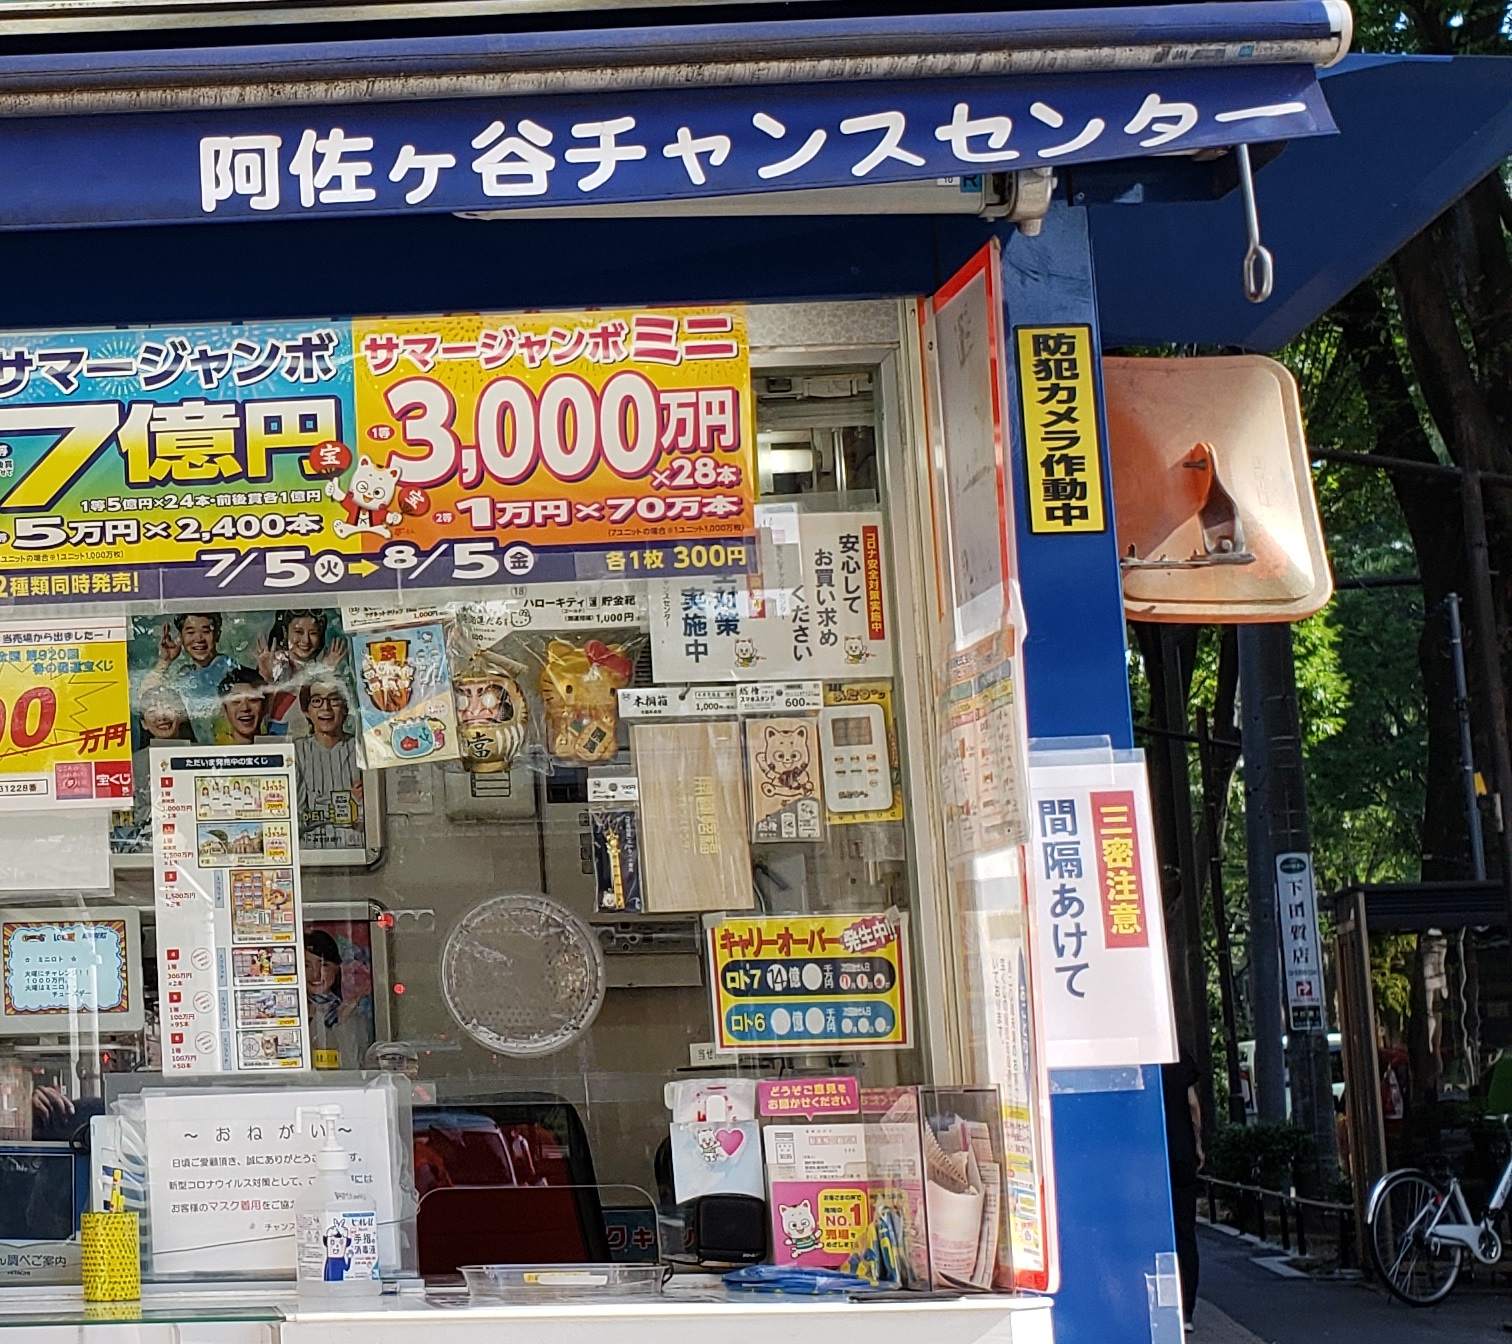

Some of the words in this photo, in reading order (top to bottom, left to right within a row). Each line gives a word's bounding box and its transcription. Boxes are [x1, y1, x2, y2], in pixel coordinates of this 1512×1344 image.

[199, 93, 1307, 212] 阿佐ヶ谷チャンスセンター
[362, 314, 738, 376] サマージャンボミニ
[319, 443, 341, 465] 宝
[370, 428, 391, 440] 1等
[383, 369, 740, 489] 3,000万円
[1032, 333, 1089, 527] 防犯カメラ作動中
[605, 549, 664, 571] 各1枚
[673, 545, 748, 568] 300円
[838, 533, 862, 614] 安心して
[524, 596, 585, 608] ハローキティ
[791, 585, 813, 662] ください
[814, 548, 839, 647] お買い求め
[77, 722, 128, 755] 万円
[1037, 798, 1091, 1001] 間隔あけて
[1099, 805, 1142, 936] 三密注意
[719, 926, 839, 958] キャリーオーバー
[726, 968, 761, 991] ロト7
[730, 1013, 766, 1033] ロト6
